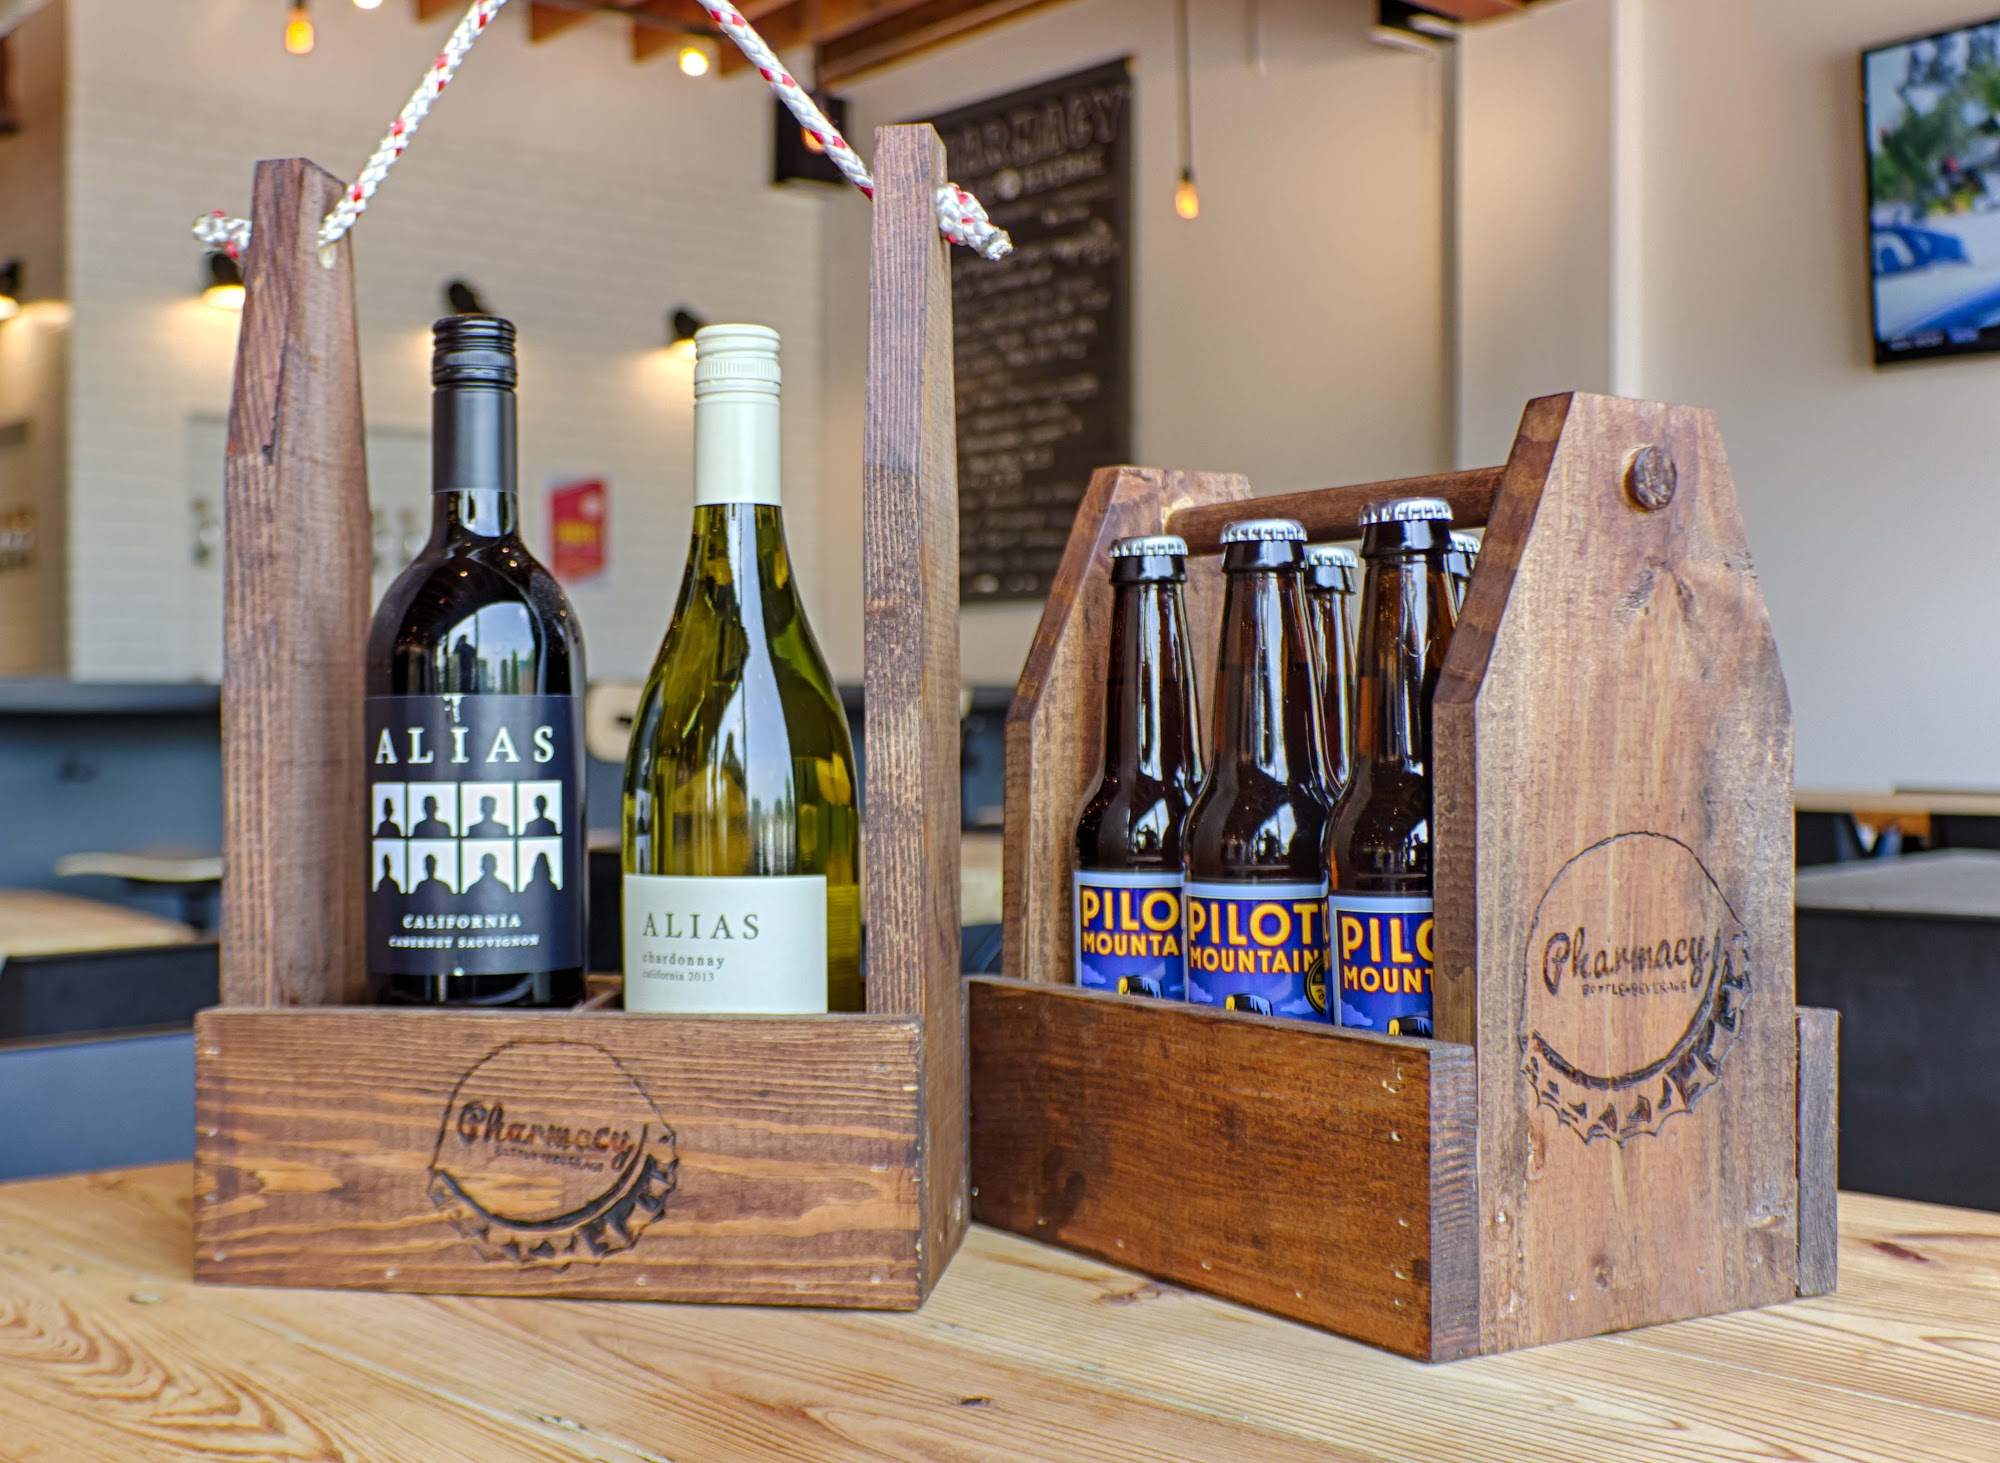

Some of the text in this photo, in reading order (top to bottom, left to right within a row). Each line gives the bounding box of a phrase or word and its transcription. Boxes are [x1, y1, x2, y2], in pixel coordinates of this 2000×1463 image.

[374, 726, 555, 763] ALIAS
[402, 913, 522, 930] CALIFORNIA
[1083, 888, 1180, 932] PILO
[1189, 901, 1319, 946] PILOT
[642, 911, 760, 939] ALIAS
[388, 933, 540, 949] CABERNET SAUVIGNON
[1083, 933, 1180, 956] MOUNTA
[1341, 916, 1433, 963] PIL
[642, 952, 725, 970] chardonnay
[1190, 945, 1319, 973] MOUNTAIN
[1543, 927, 1710, 996] Pharmacy
[642, 970, 715, 983] california 2013
[457, 1101, 635, 1173] Pharmacy
